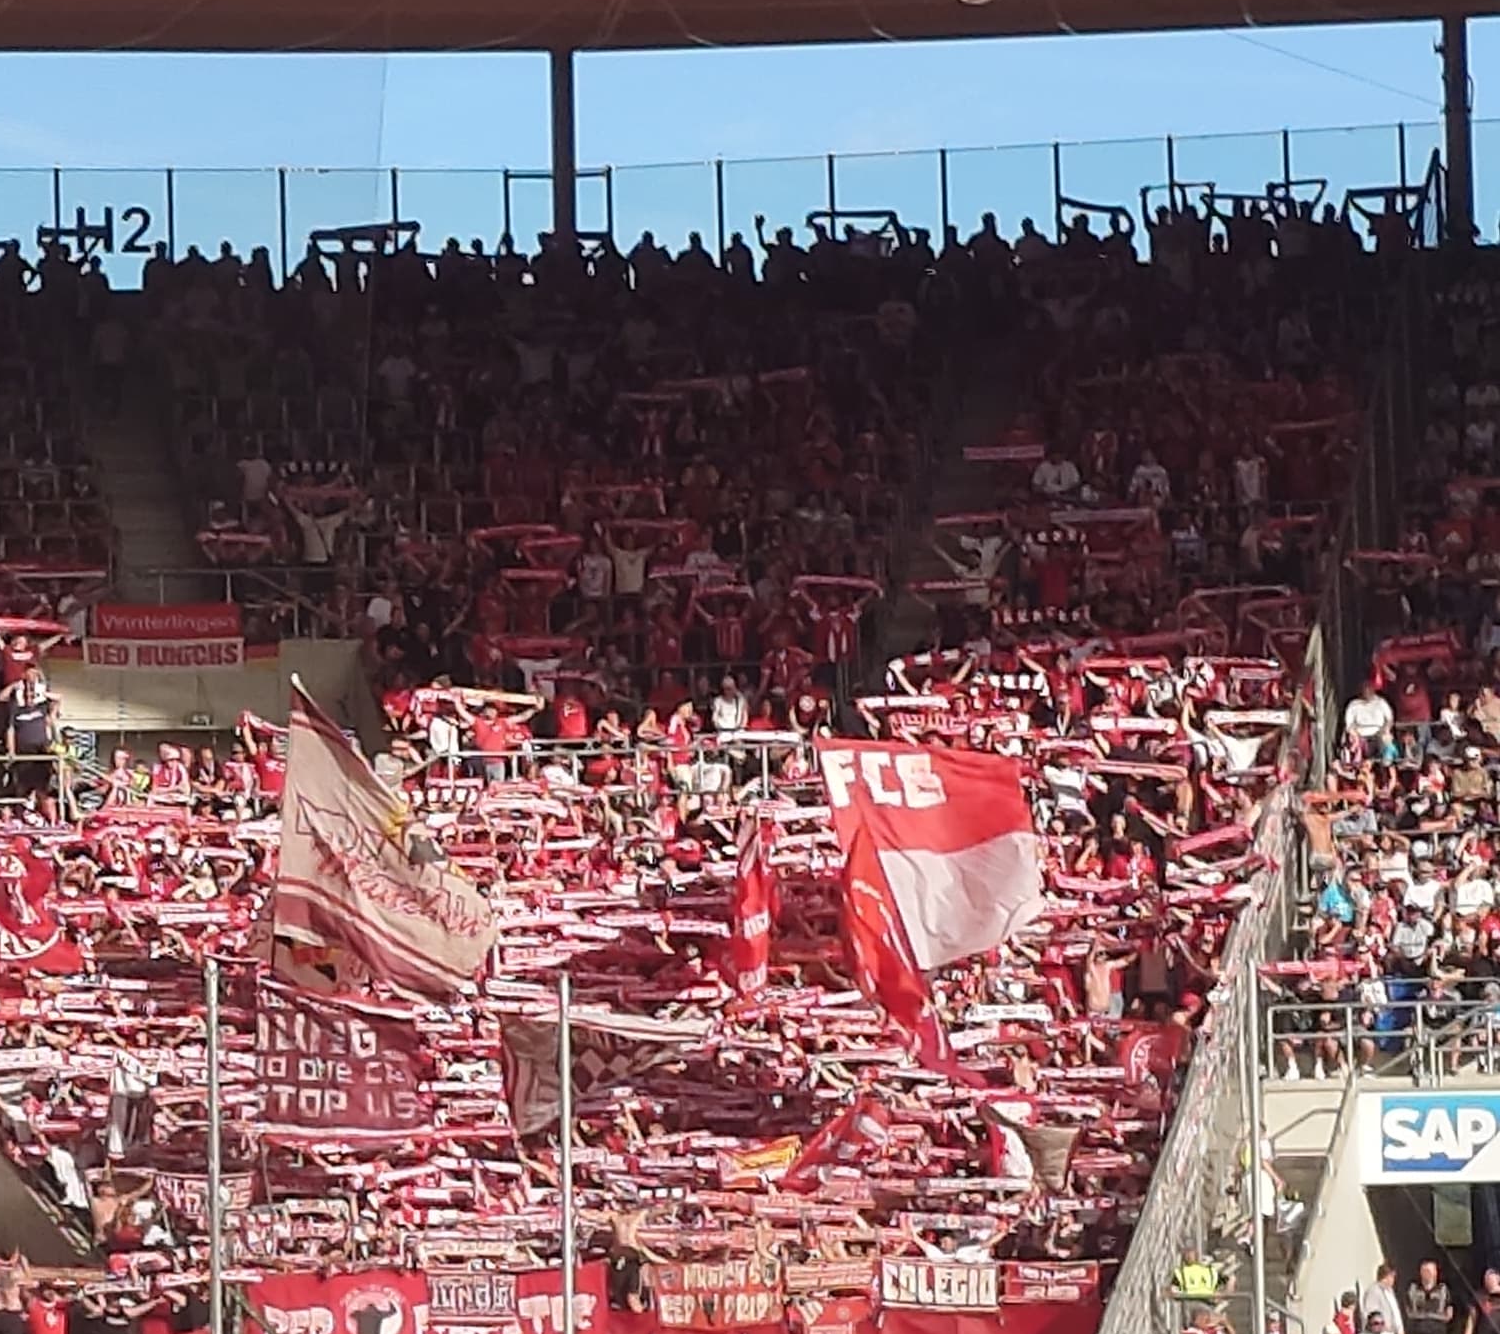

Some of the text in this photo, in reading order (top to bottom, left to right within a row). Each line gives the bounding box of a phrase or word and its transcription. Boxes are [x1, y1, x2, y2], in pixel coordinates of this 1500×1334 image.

[76, 206, 151, 254] H2
[820, 749, 947, 809] FCB
[1382, 1107, 1497, 1161] SAP
